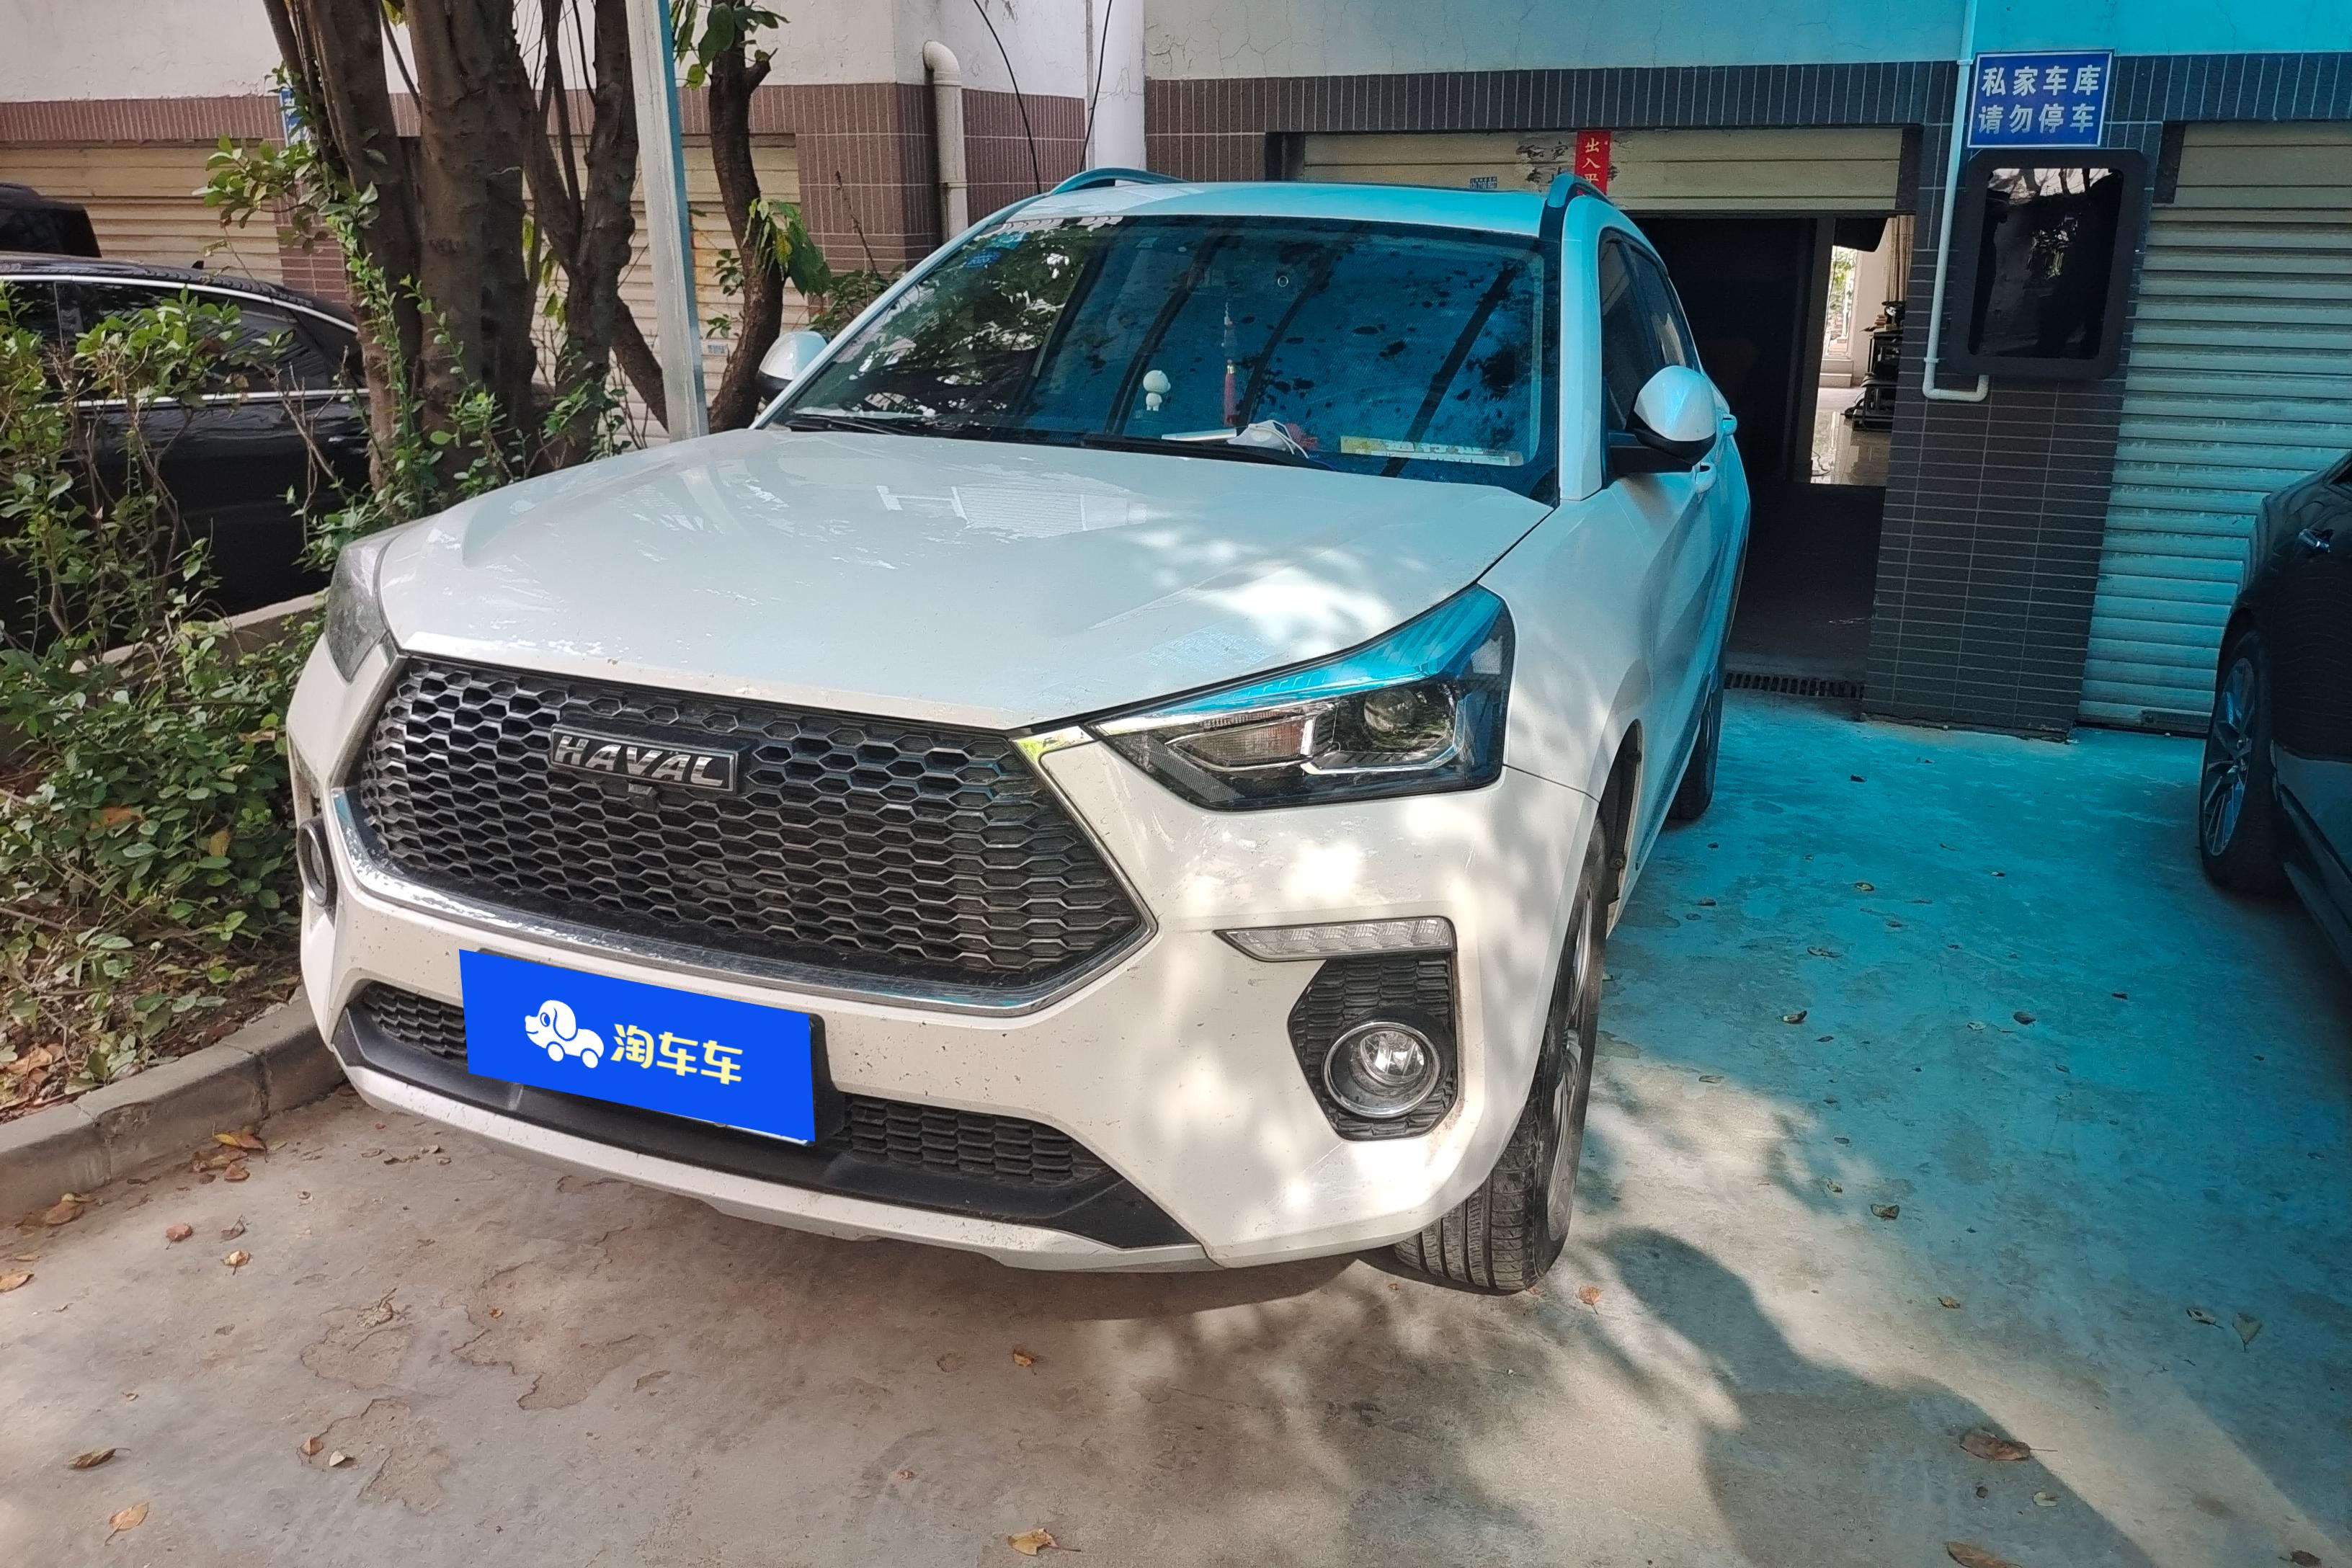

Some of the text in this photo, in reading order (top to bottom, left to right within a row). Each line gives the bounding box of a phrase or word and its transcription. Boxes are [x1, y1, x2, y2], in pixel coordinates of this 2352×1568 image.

[1981, 64, 2101, 97] 私家车库
[1978, 103, 2096, 135] 请勿停车
[553, 735, 723, 787] HAVAL
